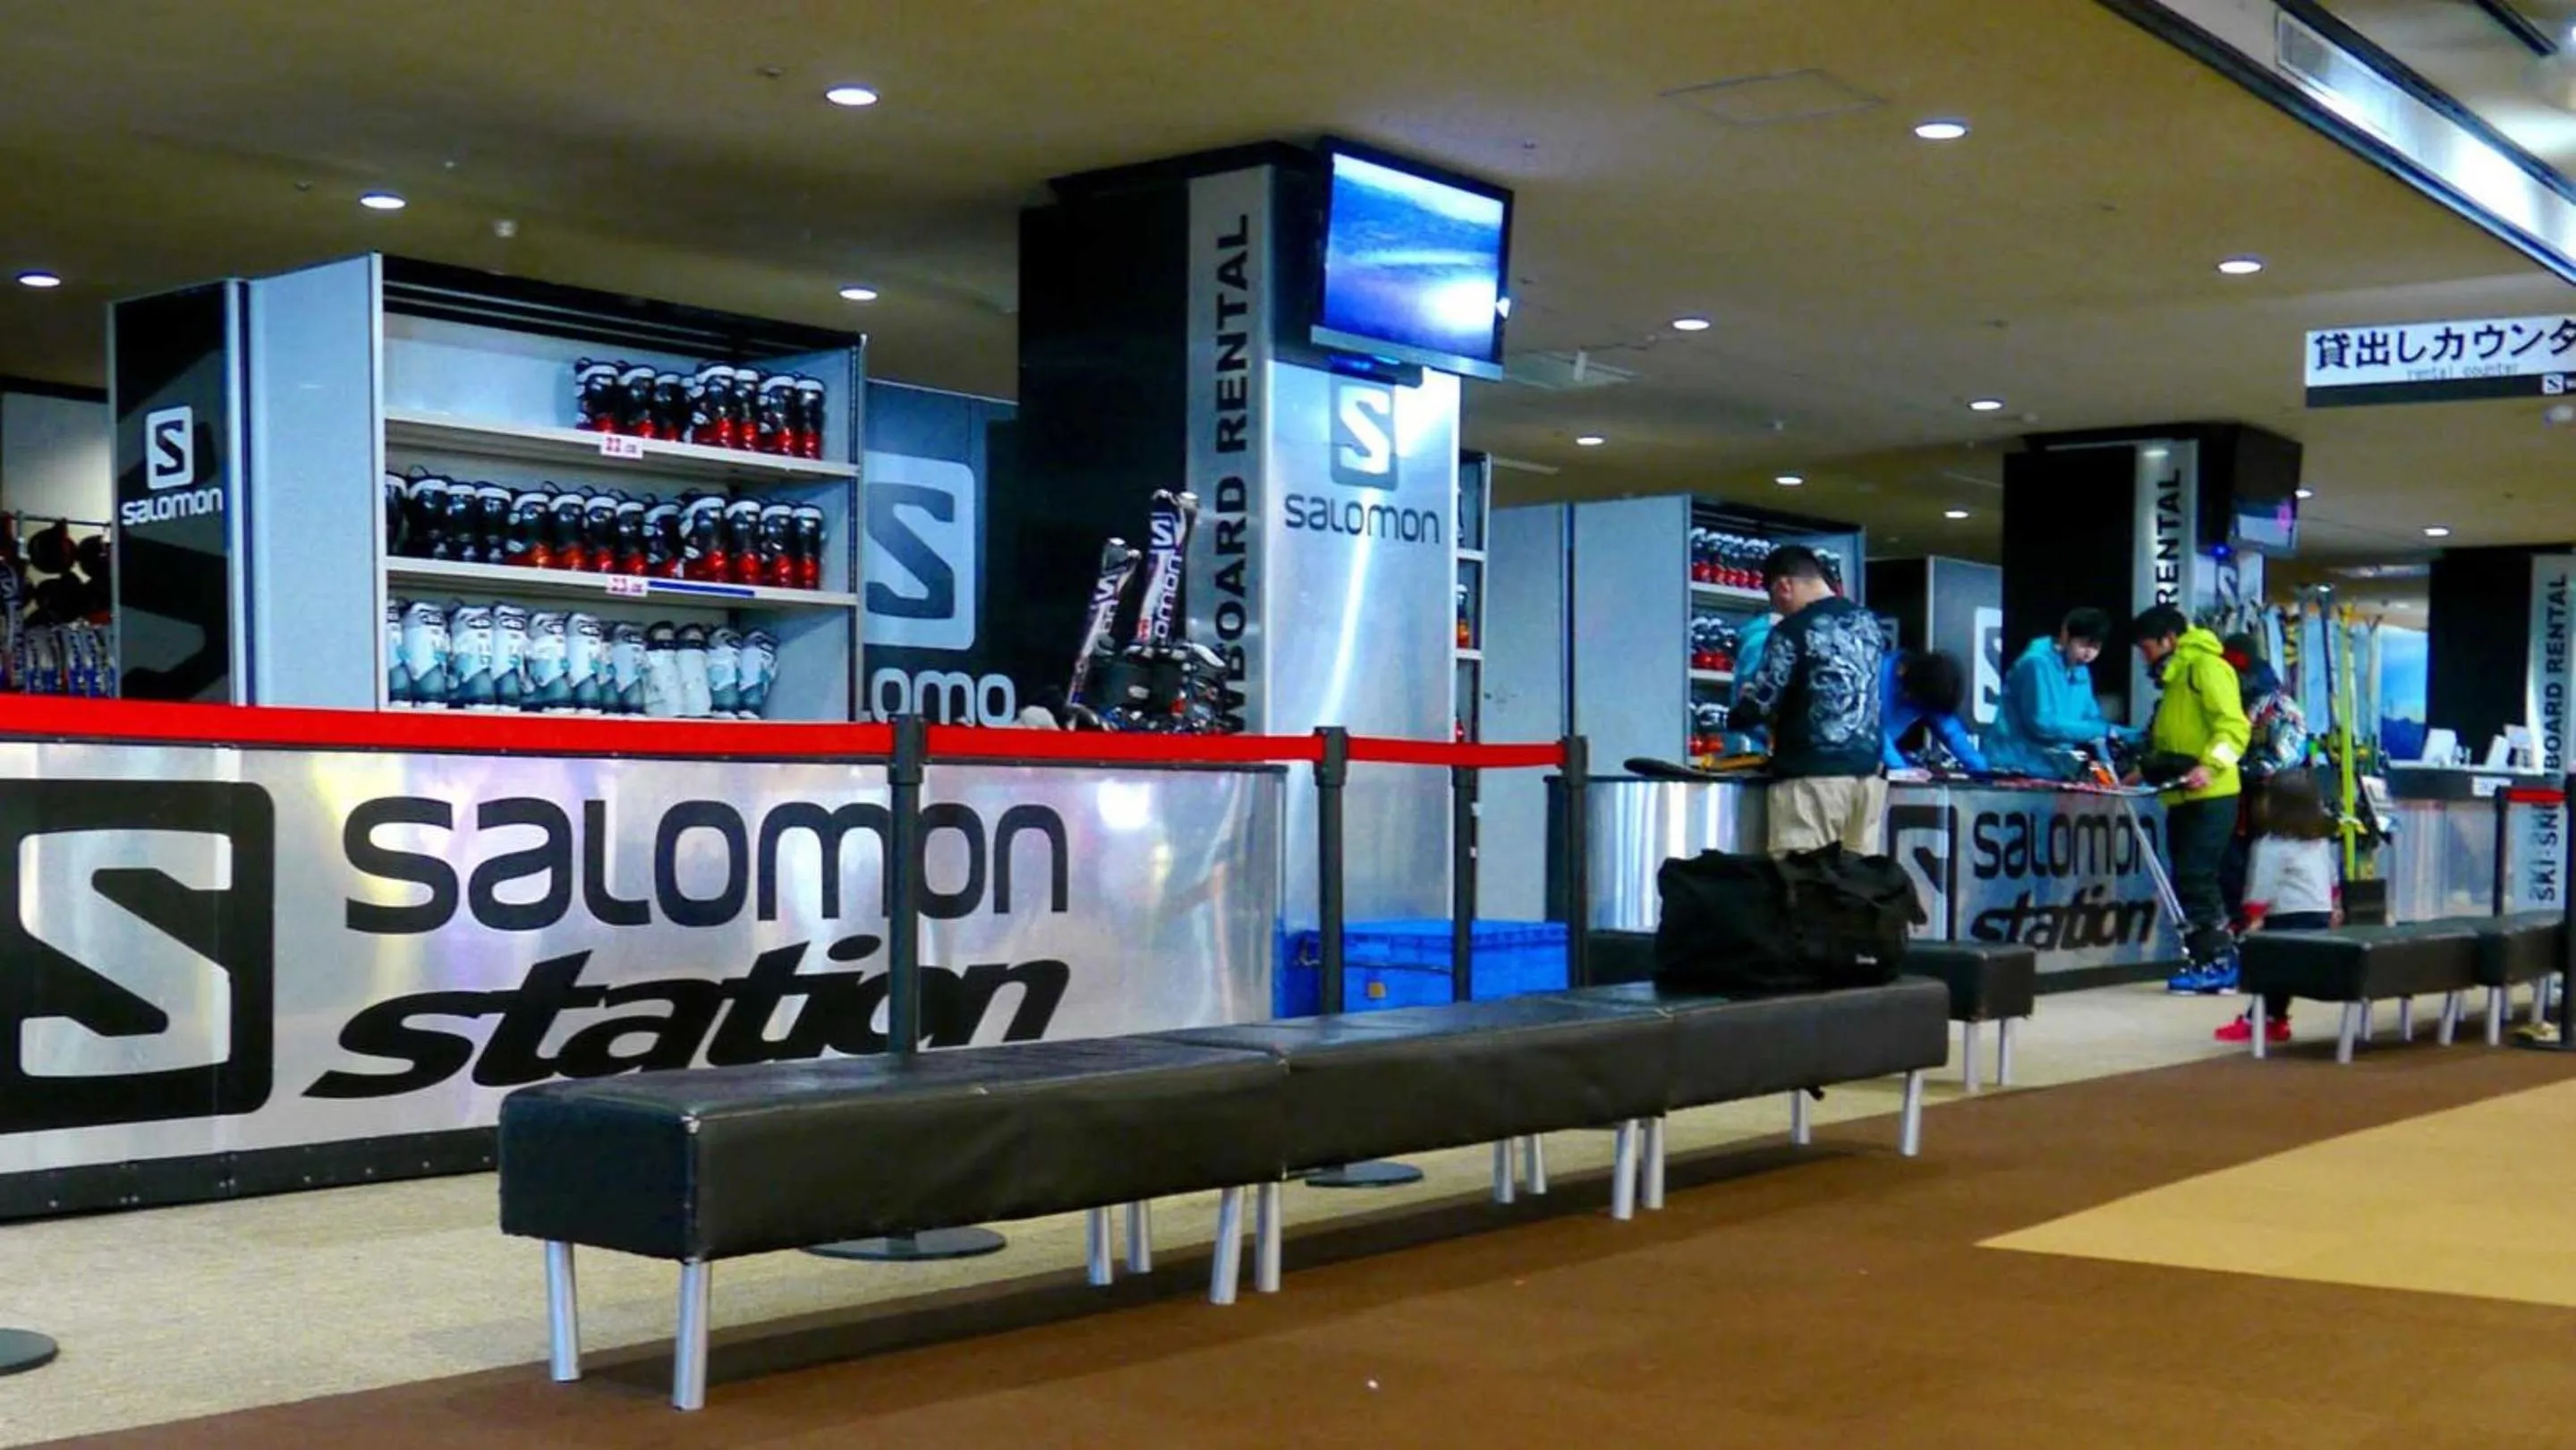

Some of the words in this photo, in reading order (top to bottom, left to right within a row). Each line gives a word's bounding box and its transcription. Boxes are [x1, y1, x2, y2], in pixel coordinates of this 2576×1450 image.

[1215, 214, 1248, 455] RENTAL
[2408, 365, 2453, 380] rental
[2463, 362, 2520, 378] counter
[2155, 468, 2181, 609] RENTAL
[2546, 573, 2568, 674] RENTAL
[1970, 884, 2156, 951] station
[302, 934, 1071, 1099] station
